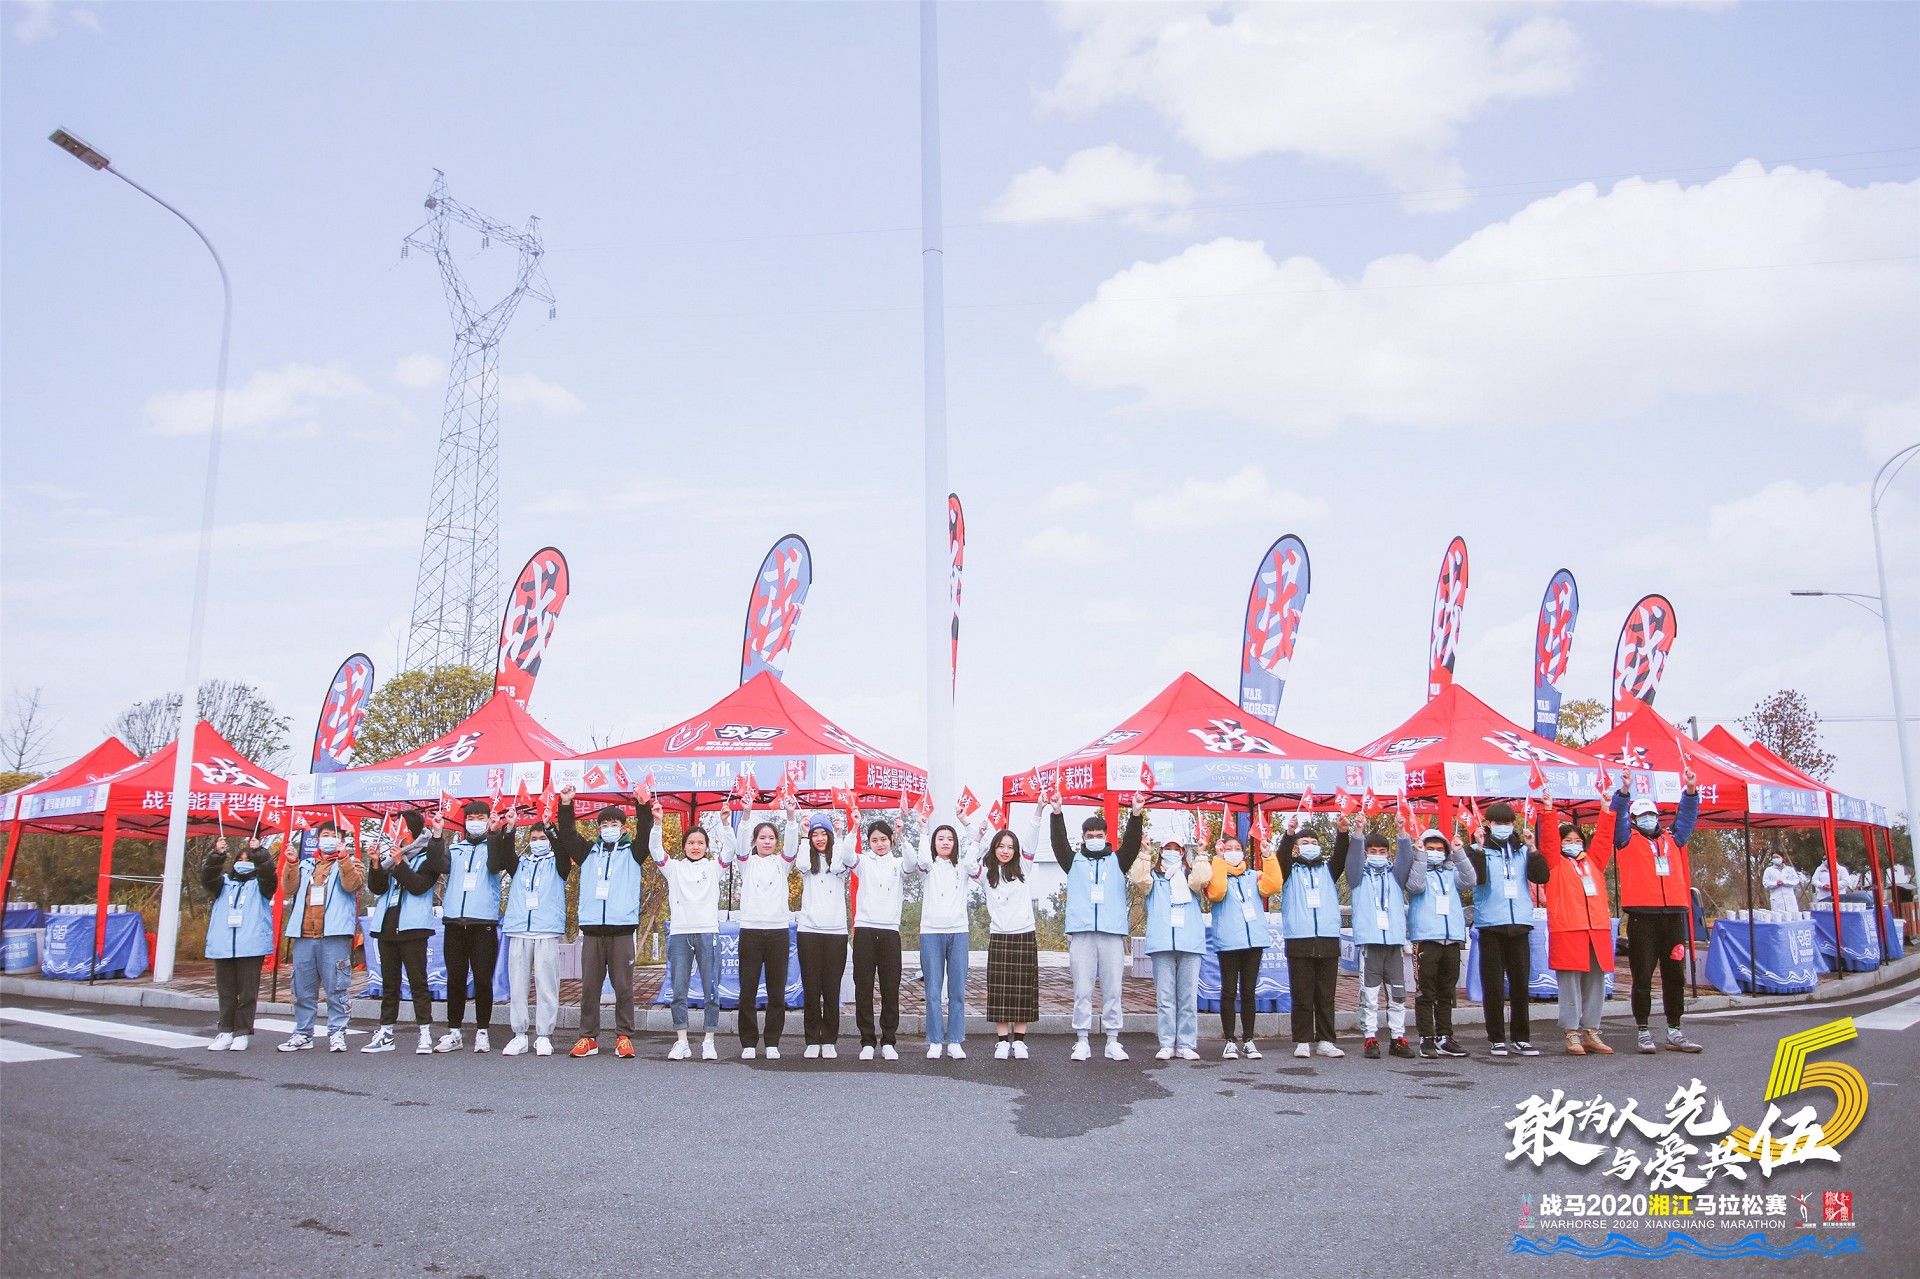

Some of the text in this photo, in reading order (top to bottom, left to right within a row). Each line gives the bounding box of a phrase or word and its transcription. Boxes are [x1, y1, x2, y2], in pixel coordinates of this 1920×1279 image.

[1243, 687, 1262, 700] WAR
[637, 764, 687, 773] VOSS
[1204, 764, 1256, 773] VOSS
[1257, 763, 1319, 780] 补水区
[359, 775, 403, 784] VOSS
[406, 770, 462, 787] 补水区
[695, 778, 719, 787] Water
[1261, 781, 1285, 790] Water
[408, 787, 430, 796] Water
